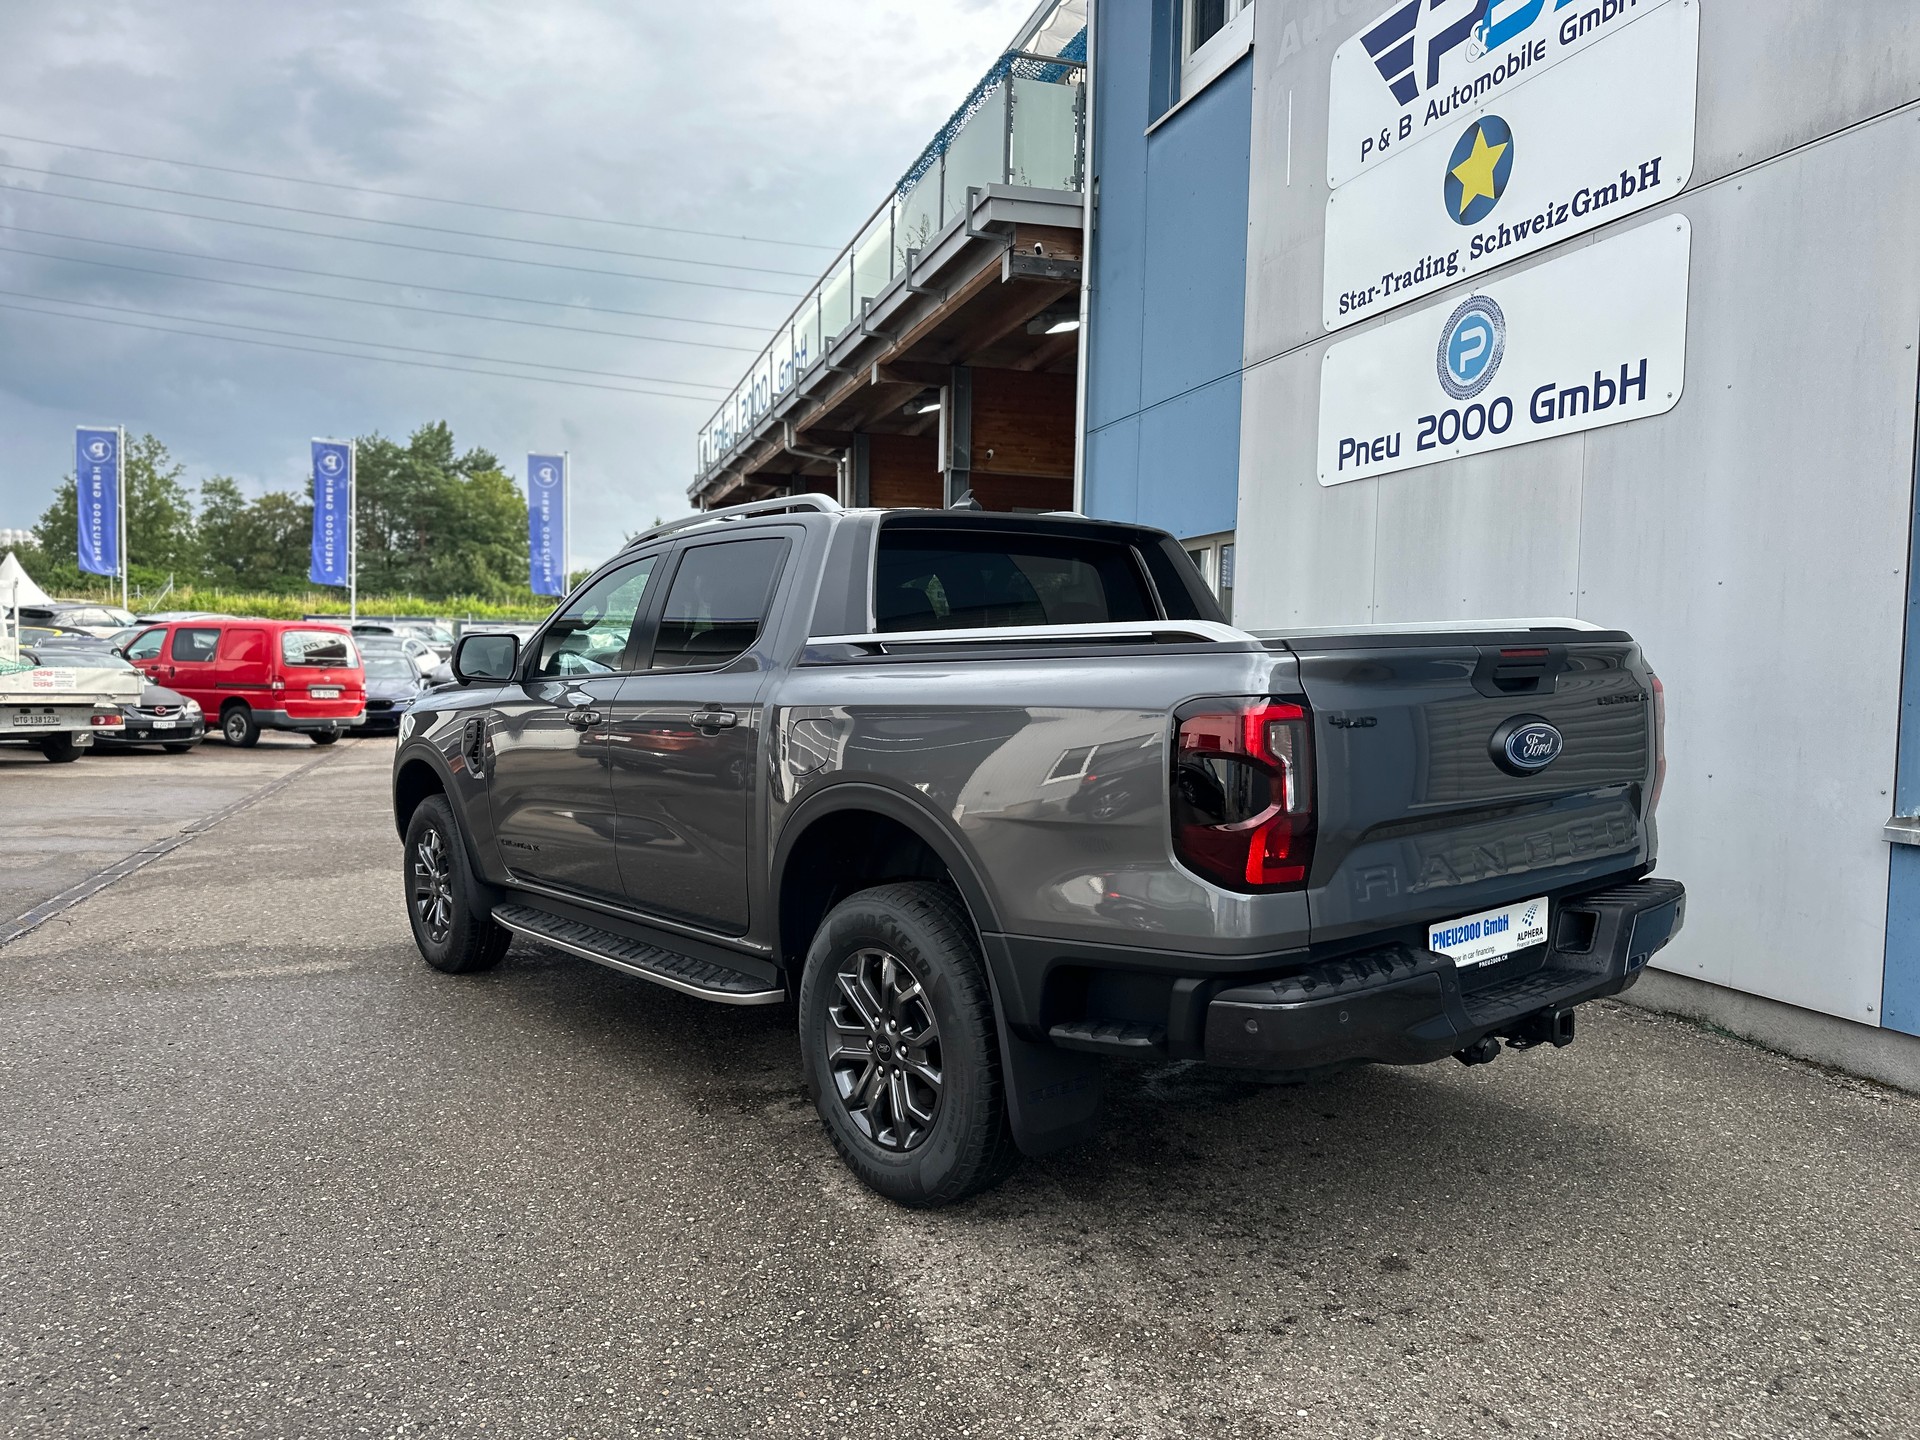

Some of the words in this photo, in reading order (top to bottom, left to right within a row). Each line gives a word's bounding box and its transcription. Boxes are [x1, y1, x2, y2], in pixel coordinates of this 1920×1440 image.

[1360, 137, 1374, 163] P
[1378, 127, 1391, 152] &
[1398, 113, 1412, 141] B
[1424, 38, 1546, 126] Automobile
[1339, 249, 1459, 315] Star-Trading
[1416, 396, 1513, 452] 2000
[1530, 358, 1648, 425] GmbH
[1523, 733, 1553, 758] Ford
[1355, 817, 1638, 902] RANGER
[1432, 921, 1480, 951] PNEU2000
[1483, 914, 1509, 937] GmbH
[1517, 927, 1544, 942] ALPHERA
